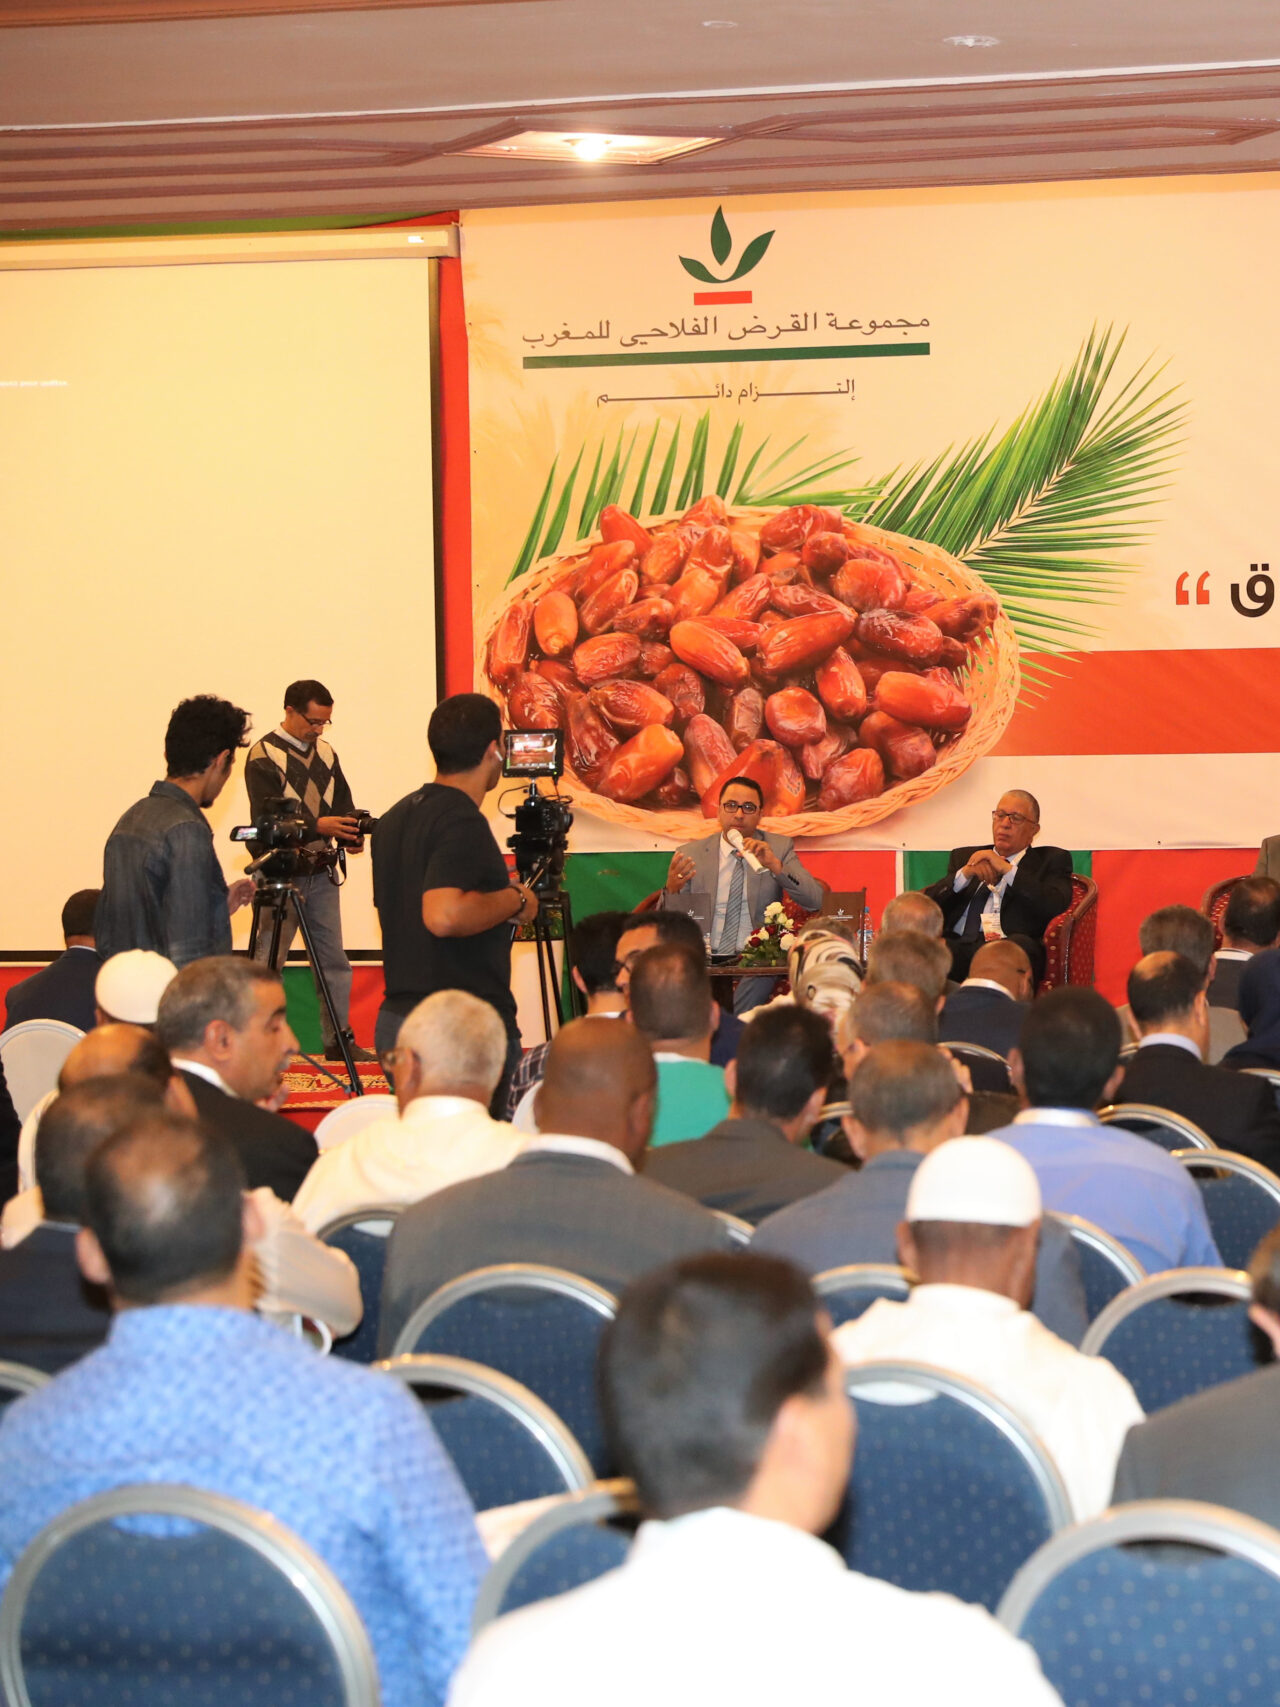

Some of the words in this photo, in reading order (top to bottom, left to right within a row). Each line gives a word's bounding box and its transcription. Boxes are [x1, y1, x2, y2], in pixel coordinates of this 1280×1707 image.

[522, 320, 610, 348] للمغرب
[728, 312, 818, 341] القرض
[828, 312, 930, 337] مجموعة
